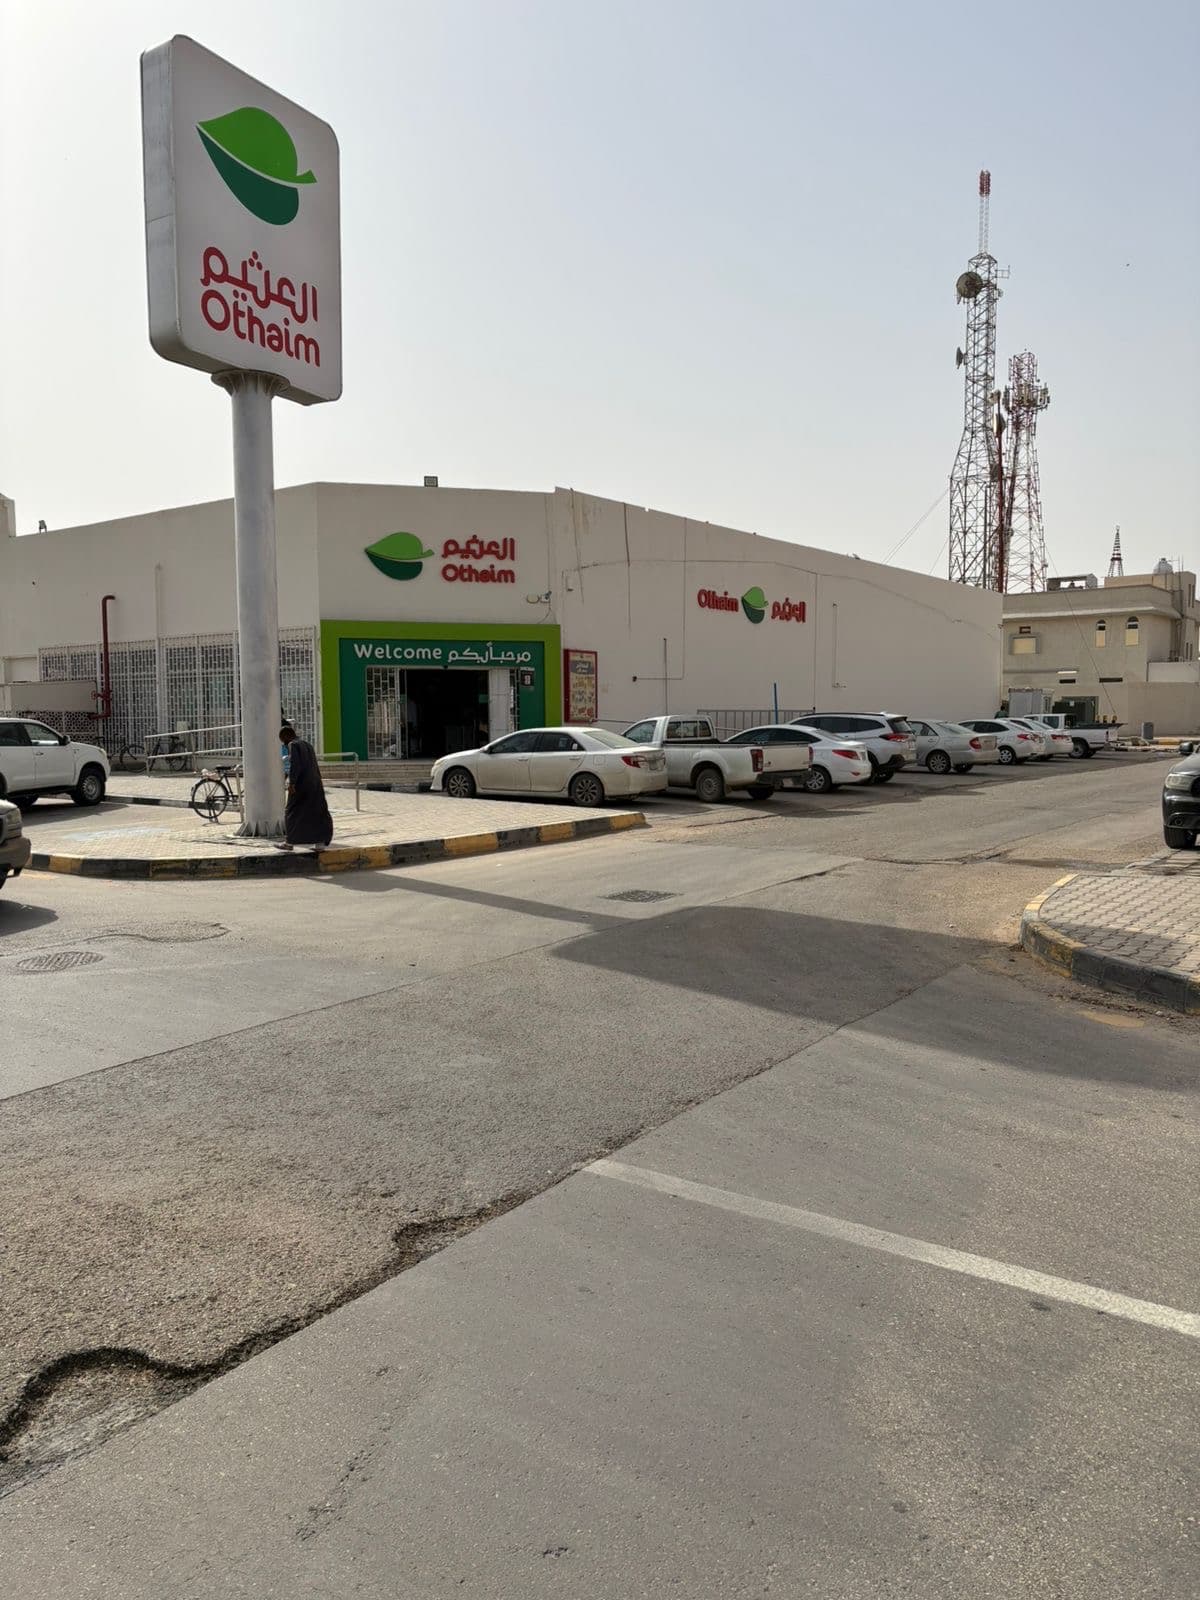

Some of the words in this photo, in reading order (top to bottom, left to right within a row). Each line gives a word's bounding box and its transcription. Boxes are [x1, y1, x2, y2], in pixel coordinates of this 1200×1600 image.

[200, 246, 318, 324] العثيم
[201, 289, 320, 367] Othaim
[441, 534, 515, 561] العثيم
[441, 563, 515, 583] Othaim
[697, 588, 739, 612] Othaim
[354, 644, 442, 660] Welcome
